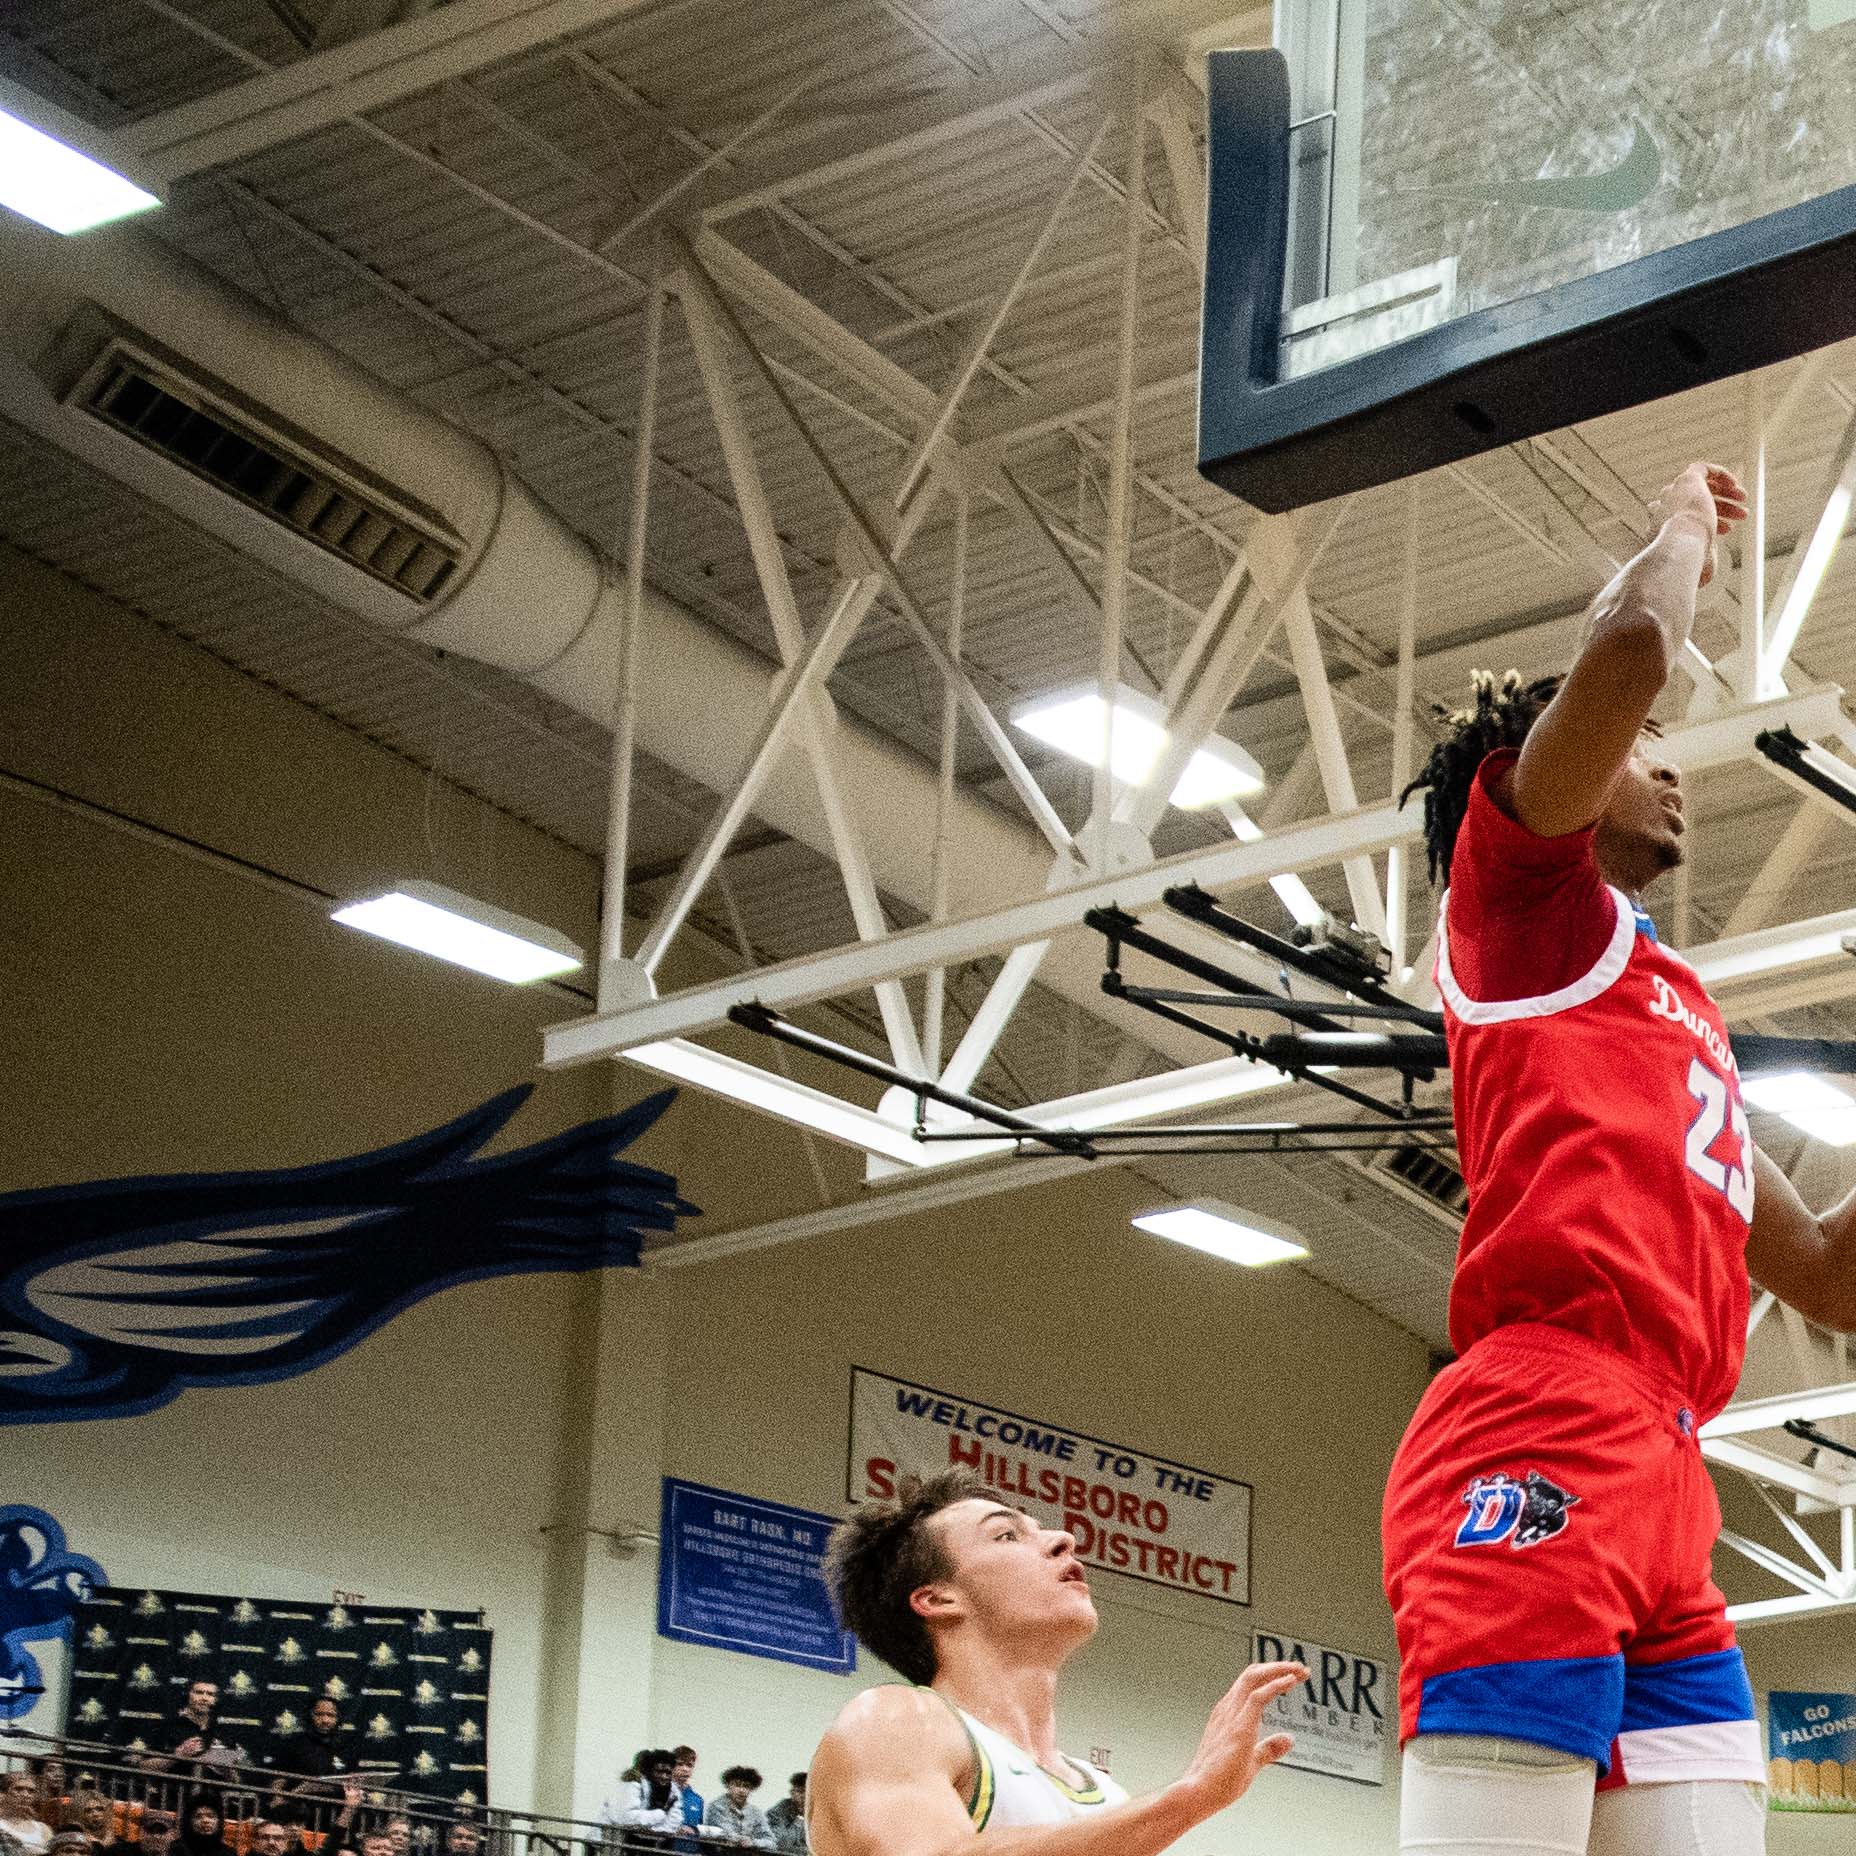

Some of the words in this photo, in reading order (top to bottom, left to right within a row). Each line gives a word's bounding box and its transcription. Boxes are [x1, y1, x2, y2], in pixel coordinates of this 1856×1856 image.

[896, 1389, 1078, 1461] WELCOME
[1094, 1446, 1137, 1479] TO
[1155, 1466, 1216, 1501] THE
[948, 1434, 1169, 1534] HILLSBORO
[1063, 1510, 1238, 1594] DISTRICT
[1276, 1697, 1385, 1736] UMBER
[1803, 1704, 1831, 1722] GO
